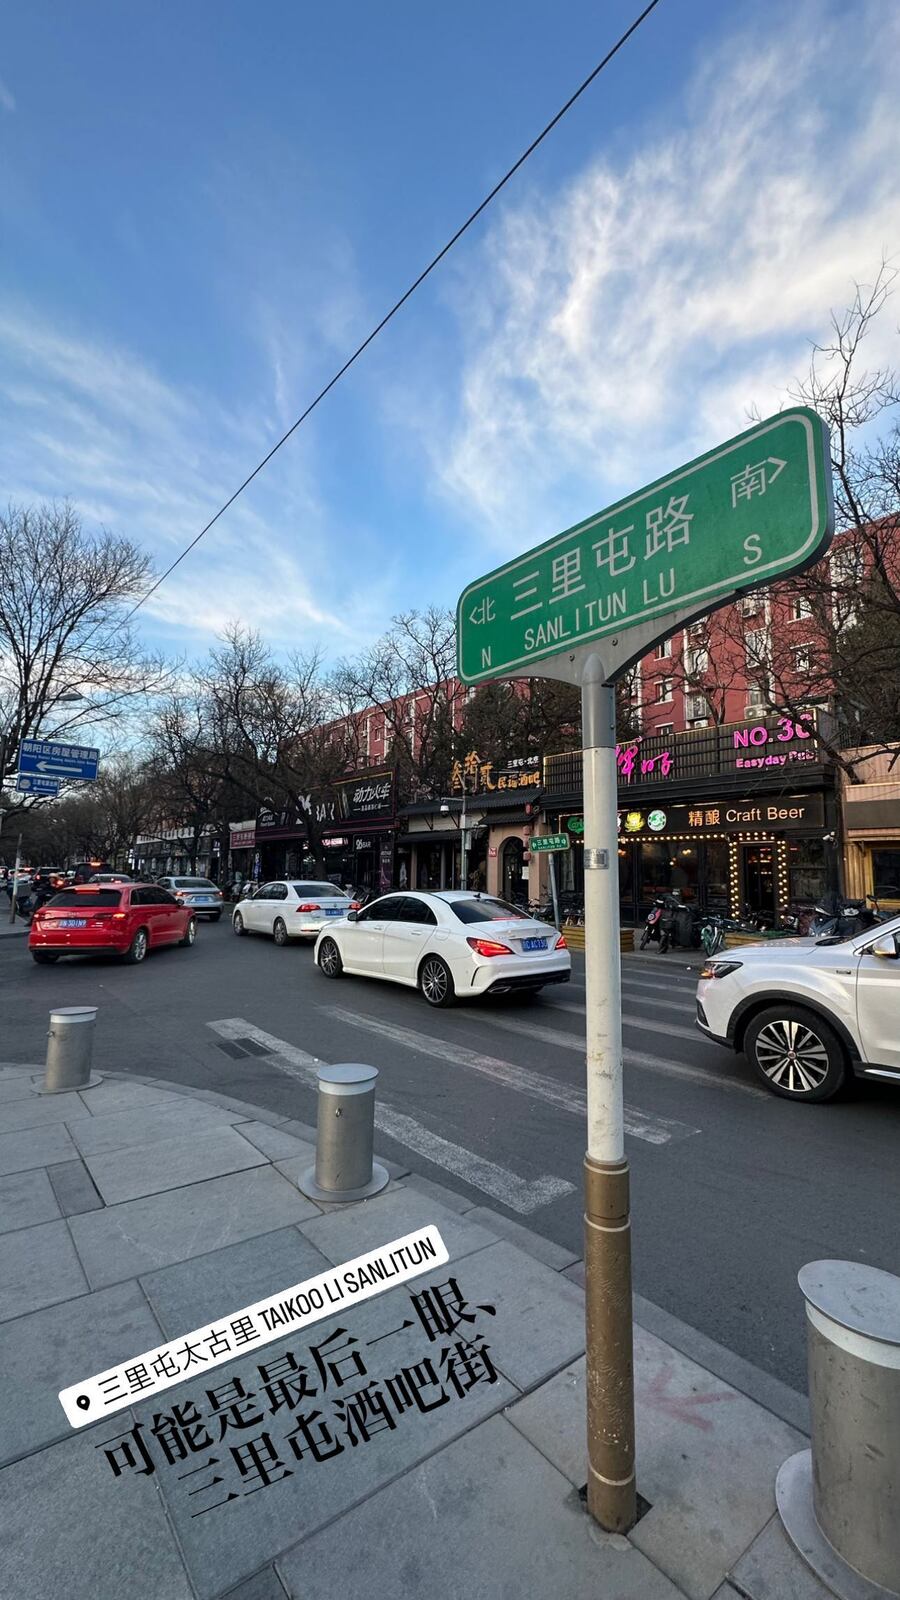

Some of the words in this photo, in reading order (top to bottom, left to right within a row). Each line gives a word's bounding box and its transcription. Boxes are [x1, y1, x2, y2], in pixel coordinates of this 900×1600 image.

[730, 463, 767, 509] 南
[510, 493, 695, 622] 三里屯路
[742, 533, 763, 565] S
[477, 595, 497, 625] 北
[523, 587, 627, 651] SANLITUN
[642, 568, 676, 606] LU
[481, 646, 492, 669] N
[736, 755, 787, 769] Easyday
[353, 782, 391, 803] 动力火车
[688, 810, 720, 827] 精酿
[725, 808, 762, 822] Craft
[766, 806, 805, 820] Beer
